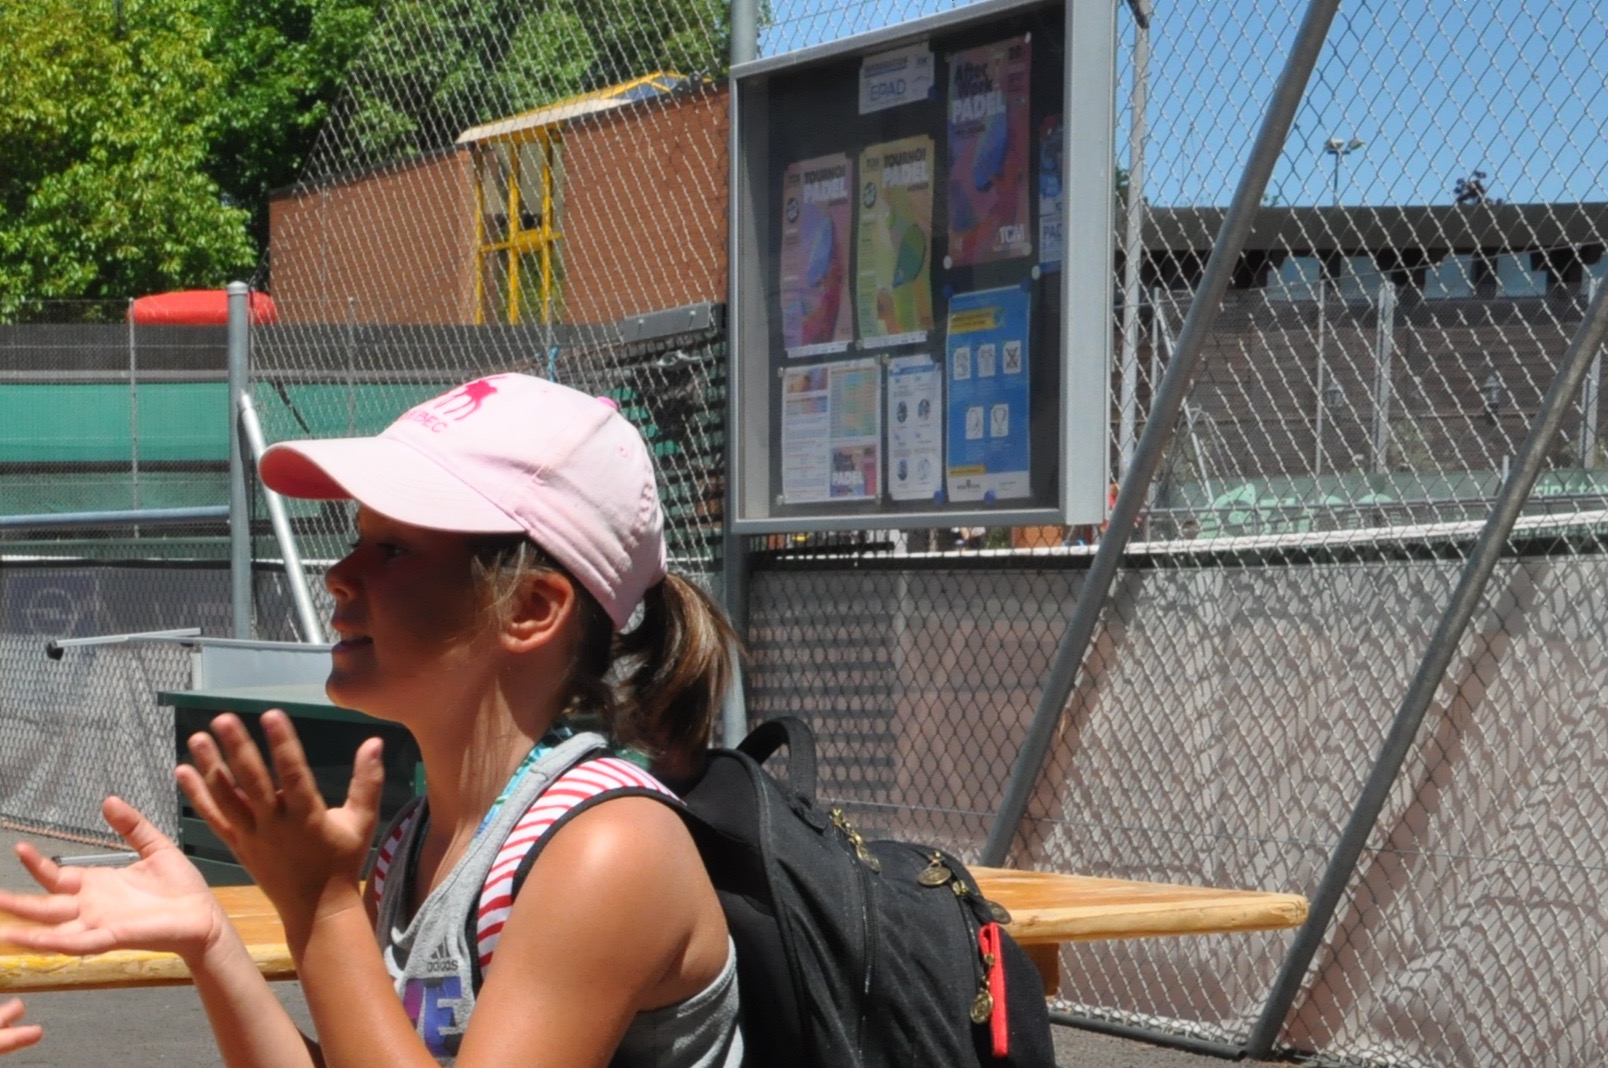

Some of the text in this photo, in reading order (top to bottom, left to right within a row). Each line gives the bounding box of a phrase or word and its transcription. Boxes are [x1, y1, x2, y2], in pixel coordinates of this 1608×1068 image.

[952, 91, 1007, 123] PADEL
[884, 147, 927, 168] TOURNOI
[803, 165, 846, 184] TOURNOI
[882, 160, 929, 188] PADEL
[803, 177, 848, 204] PADEL
[832, 471, 864, 485] PADEL
